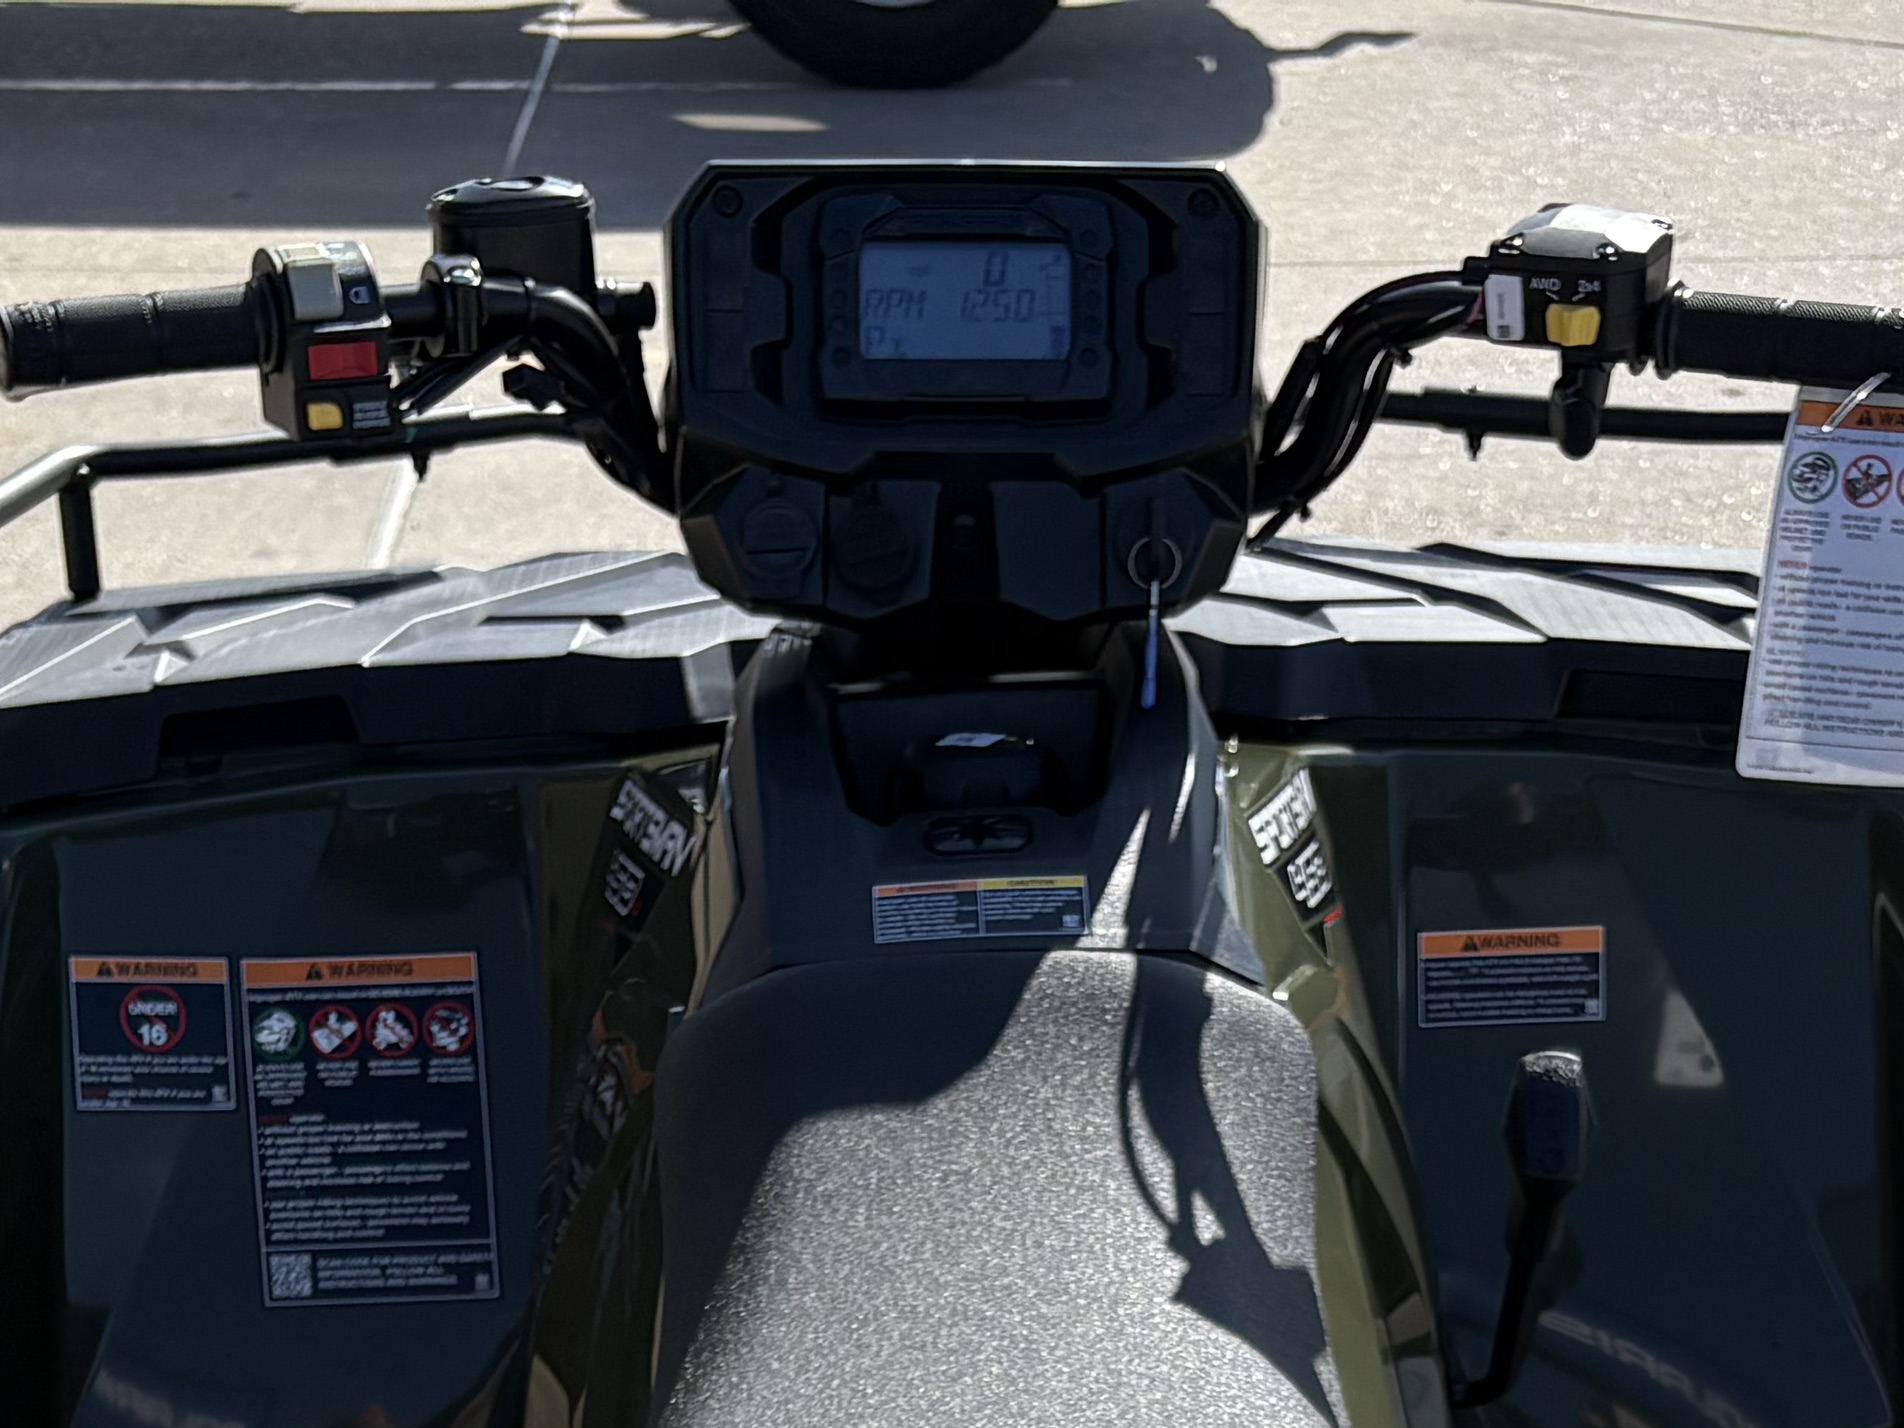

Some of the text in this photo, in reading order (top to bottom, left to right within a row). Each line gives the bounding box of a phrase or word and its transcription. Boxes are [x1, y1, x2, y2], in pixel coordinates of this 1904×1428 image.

[1529, 277, 1562, 291] AWD
[863, 288, 1036, 323] RPM 1250
[1478, 933, 1561, 949] WARNING
[116, 962, 199, 977] WARNING
[327, 962, 414, 979] WARNING
[128, 1000, 178, 1016] UNDER
[138, 1023, 169, 1046] 16
